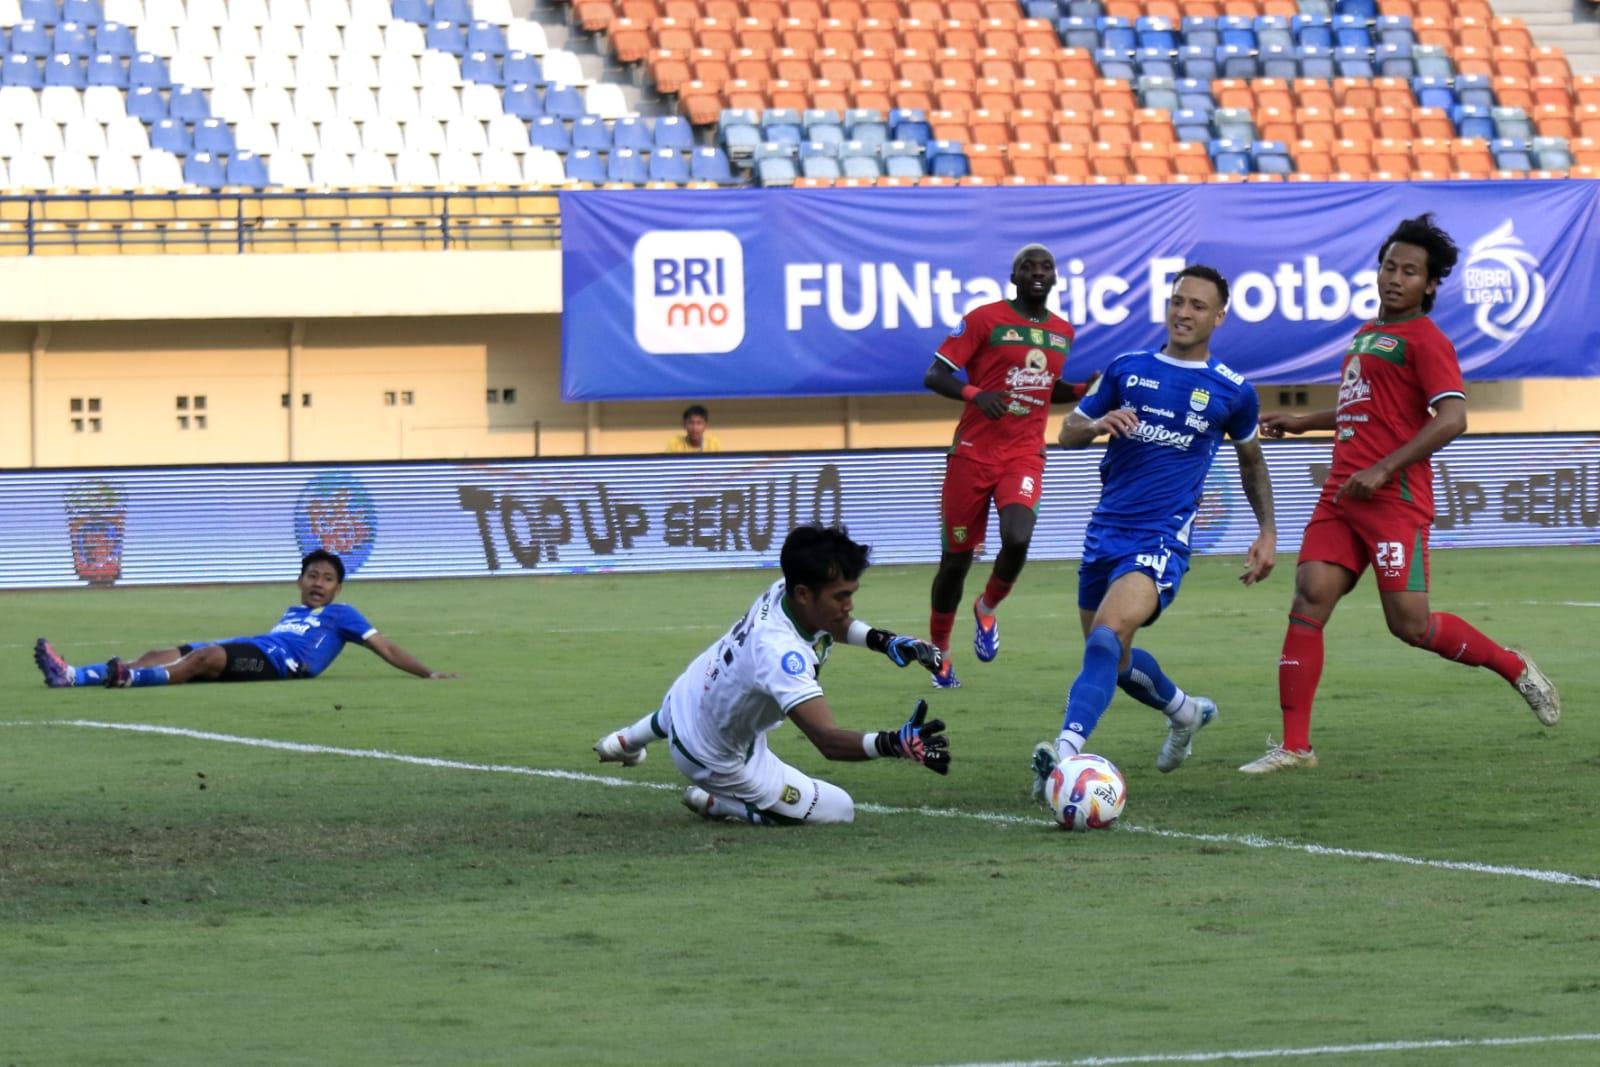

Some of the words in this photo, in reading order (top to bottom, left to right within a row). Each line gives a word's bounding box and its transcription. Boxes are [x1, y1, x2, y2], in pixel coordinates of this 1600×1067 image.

[654, 257, 726, 297] BRI
[1150, 255, 1382, 324] Fotba
[1484, 269, 1512, 290] BRI
[667, 302, 729, 327] mo
[1375, 541, 1406, 569] 23
